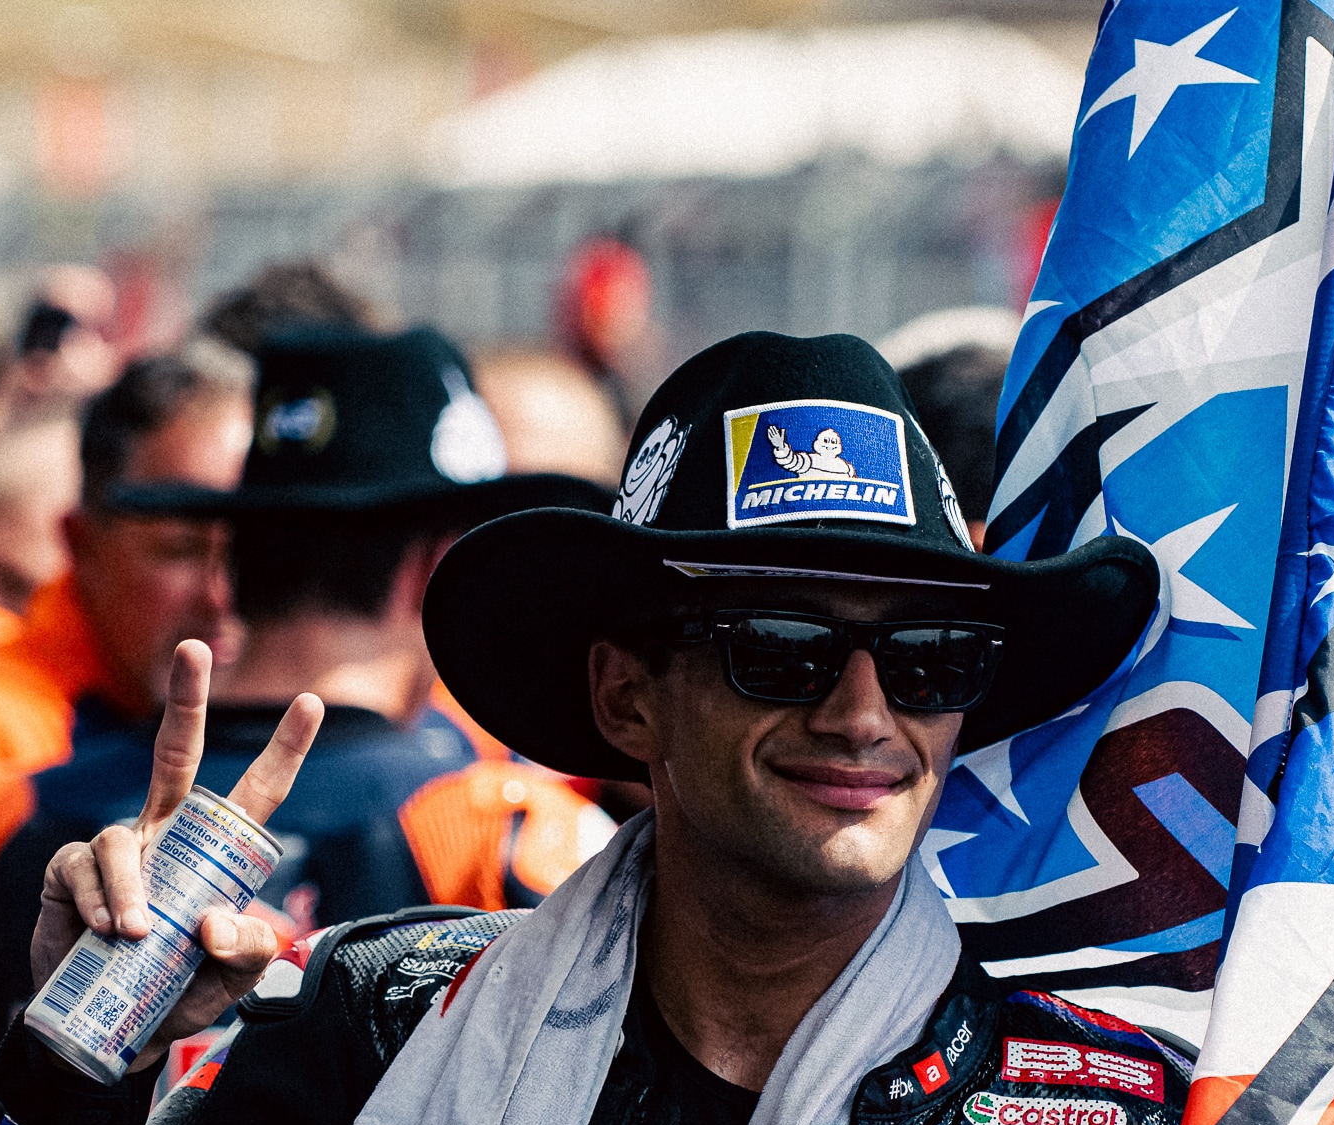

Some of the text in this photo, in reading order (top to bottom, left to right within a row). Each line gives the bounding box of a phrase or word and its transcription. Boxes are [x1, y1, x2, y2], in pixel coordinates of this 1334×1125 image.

[741, 484, 897, 509] MICHELIN
[171, 823, 190, 838] Serving
[191, 836, 204, 847] size
[212, 808, 227, 821] 8.4
[228, 819, 239, 829] FL
[240, 827, 254, 841] OZ
[160, 839, 198, 866] Calories
[177, 815, 218, 845] Nutrition
[220, 845, 249, 868] Facts
[159, 859, 169, 867] Fat
[186, 848, 203, 861] serving
[152, 873, 185, 896] Carbohydrate
[889, 1078, 914, 1099] #be
